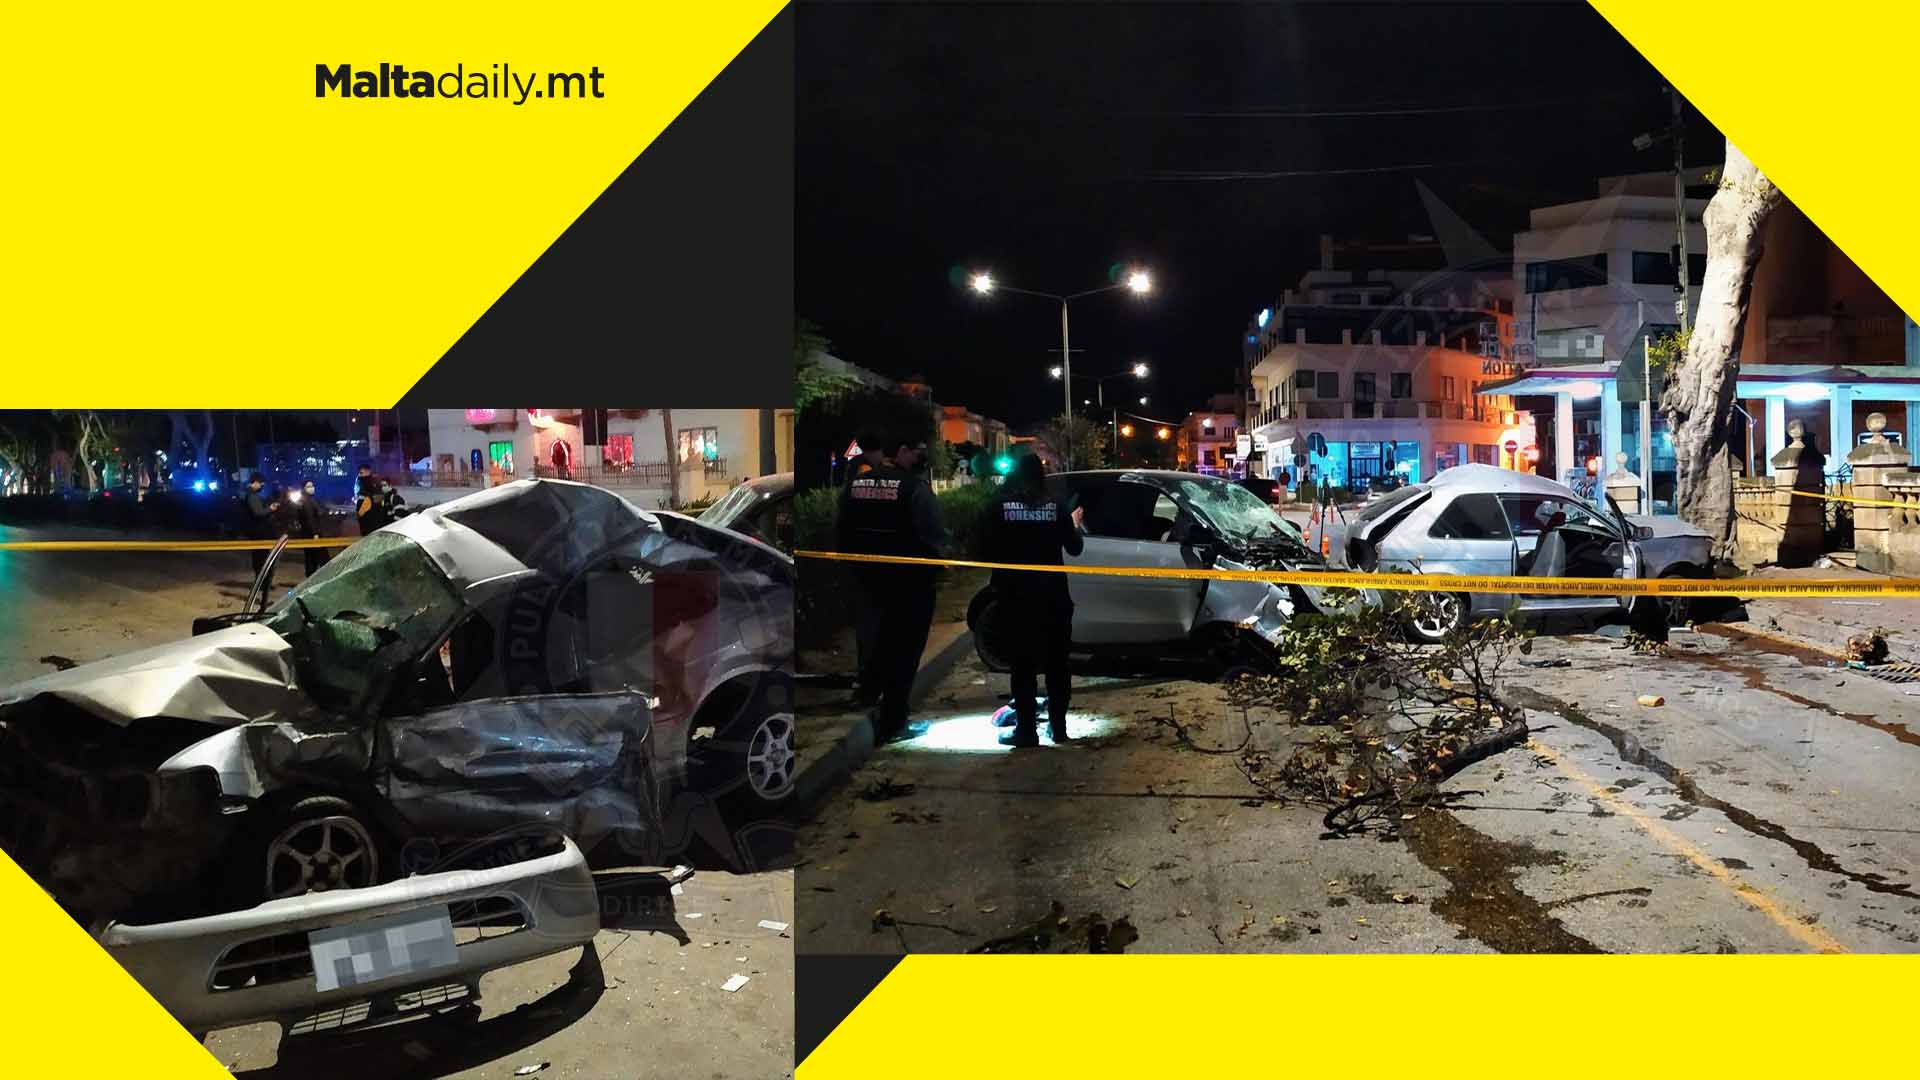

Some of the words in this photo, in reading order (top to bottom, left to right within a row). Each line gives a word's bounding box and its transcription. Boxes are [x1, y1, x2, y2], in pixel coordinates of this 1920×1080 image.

[1478, 580, 1488, 588] DO
[1489, 581, 1521, 589] HOSPITAL
[1560, 583, 1603, 591] AMBULANCE
[1605, 584, 1648, 592] EMERGENCY
[1658, 584, 1682, 592] CROSS
[1684, 584, 1698, 592] NOT
[1700, 584, 1711, 592] DO
[1712, 584, 1746, 592] HOSPITAL
[1762, 584, 1787, 592] MATER
[1789, 583, 1834, 592] AMBULANCE
[1836, 583, 1882, 592] EMERGENCY
